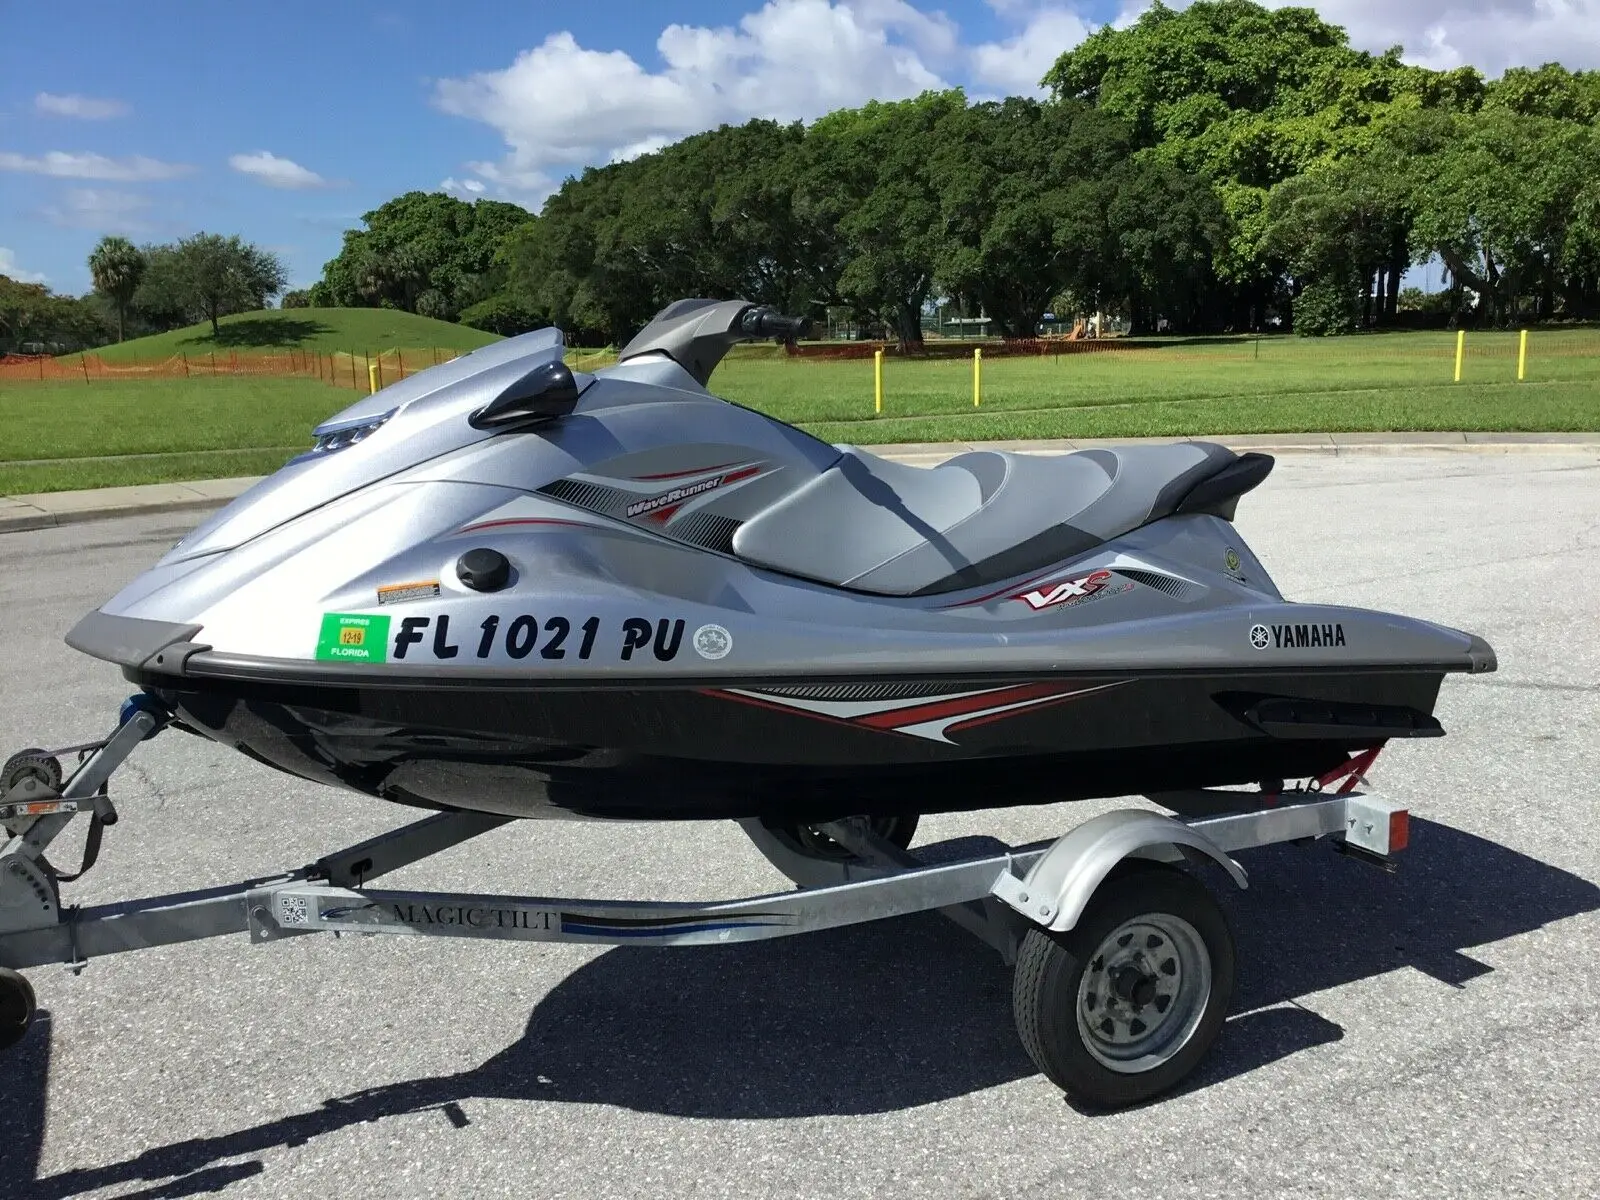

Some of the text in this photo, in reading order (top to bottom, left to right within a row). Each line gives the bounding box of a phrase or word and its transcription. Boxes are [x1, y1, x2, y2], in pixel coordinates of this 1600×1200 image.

[626, 476, 722, 518] WaveRunner
[343, 632, 362, 644] 12-19
[393, 614, 458, 660] FL
[476, 615, 600, 661] 1021
[620, 616, 686, 661] PU
[1271, 623, 1346, 649] YAMAHA
[331, 648, 369, 657] FLORIDA
[393, 904, 557, 930] MAGIC TILT
